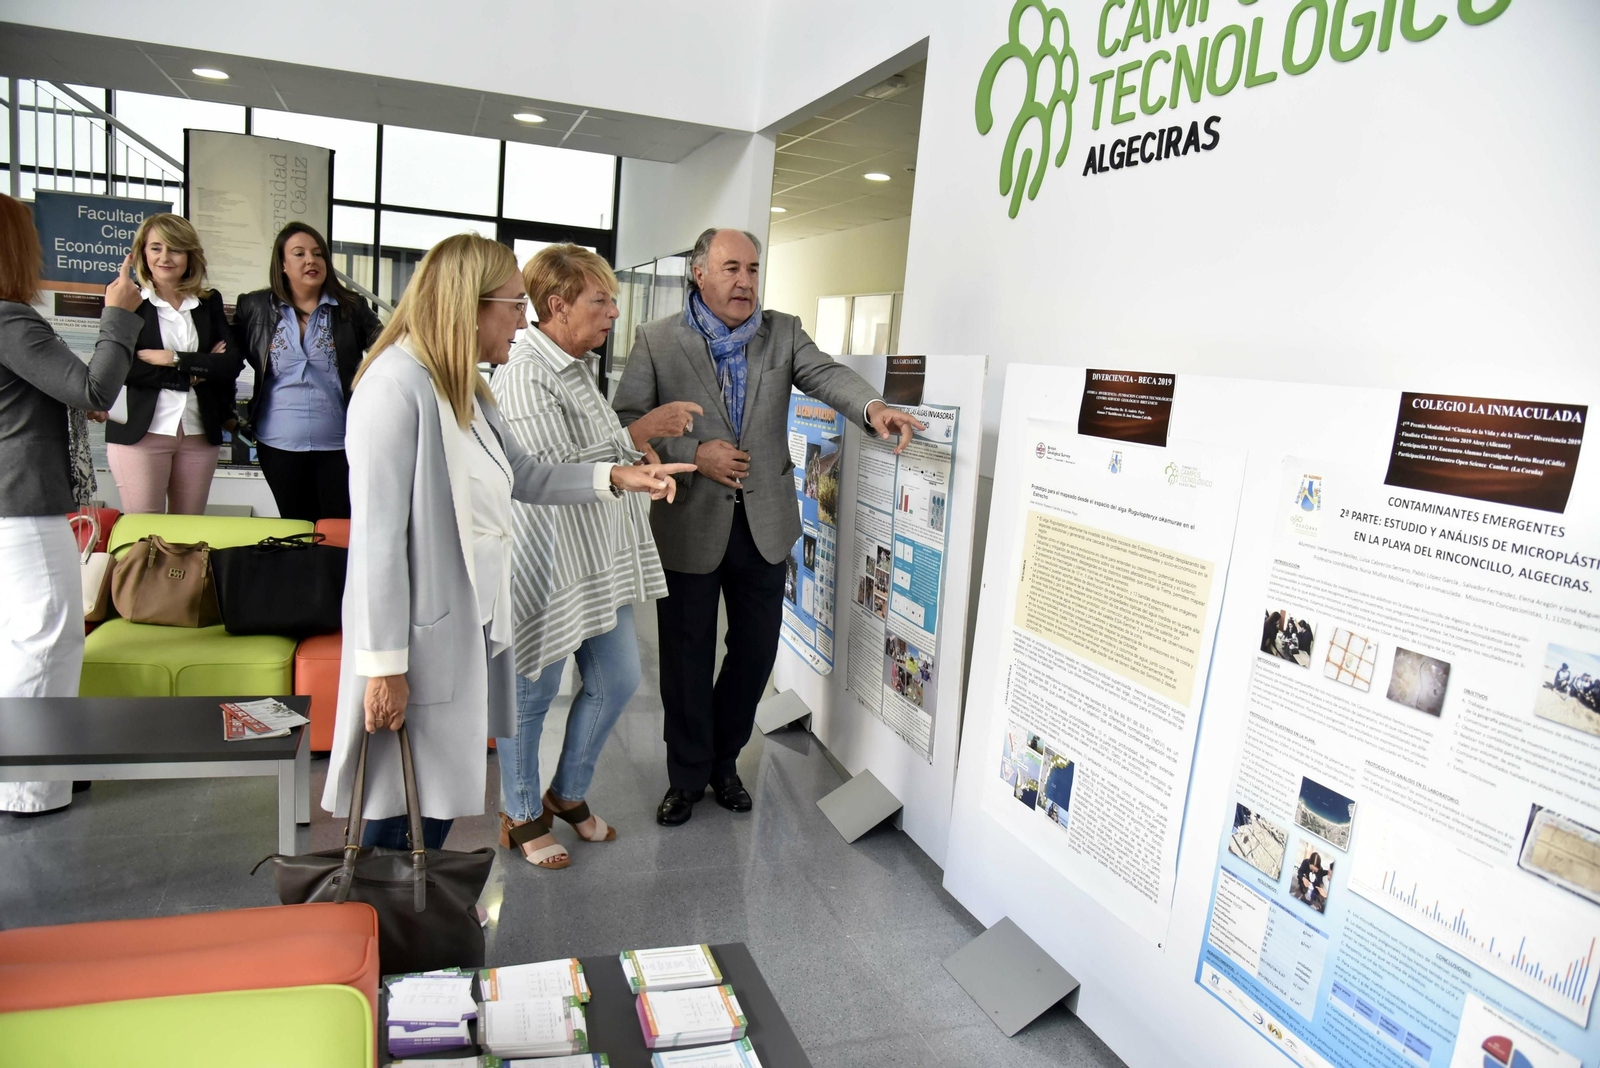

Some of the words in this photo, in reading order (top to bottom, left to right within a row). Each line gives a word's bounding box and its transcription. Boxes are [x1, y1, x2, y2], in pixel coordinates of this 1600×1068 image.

[1097, 0, 1258, 57] CAM
[1082, 115, 1221, 177] ALGECIRAS
[290, 157, 307, 214] Cádiz
[78, 205, 144, 224] Facultad
[101, 225, 137, 240] Cien
[54, 237, 132, 256] Económic
[57, 255, 123, 273] Empresa
[1092, 373, 1133, 383] DIVERCIENCIA
[1138, 376, 1156, 385] BECA
[1158, 378, 1172, 386] 2019
[917, 409, 928, 417] ALGAS
[928, 411, 954, 420] INVASORAS
[1412, 398, 1466, 412] COLEGIO
[1468, 403, 1485, 414] LA
[1487, 404, 1582, 423] INMACULADA
[1486, 441, 1511, 450] (Alicante)
[1534, 435, 1567, 444] Diverciencia
[1398, 451, 1426, 459] Participación
[1399, 441, 1428, 449] Participación
[1439, 446, 1463, 454] Encuentro
[1483, 451, 1513, 460] Investigador
[1514, 455, 1531, 463] Puerto
[1544, 459, 1566, 468] (Cádiz)
[1180, 469, 1201, 478] CAMPUS
[1128, 508, 1158, 521] Rugulopteryx
[1388, 497, 1479, 522] CONTAMINANTES
[1482, 513, 1565, 538] EMERGENTES
[1339, 508, 1349, 518] 2ª
[1351, 511, 1382, 526] PARTE:
[1384, 517, 1427, 535] ESTUDIO
[1430, 526, 1437, 537] Y
[1438, 529, 1489, 548] ANÁLISIS
[1492, 539, 1508, 552] DE
[1511, 543, 1600, 570] MICROPLÁSTI
[1354, 531, 1366, 542] EN
[1368, 535, 1379, 545] LA
[1382, 537, 1411, 552] PLAYA
[1414, 544, 1432, 557] DEL
[1435, 549, 1515, 577] RINCONCILLO,
[1518, 568, 1593, 593] ALGECIRAS.
